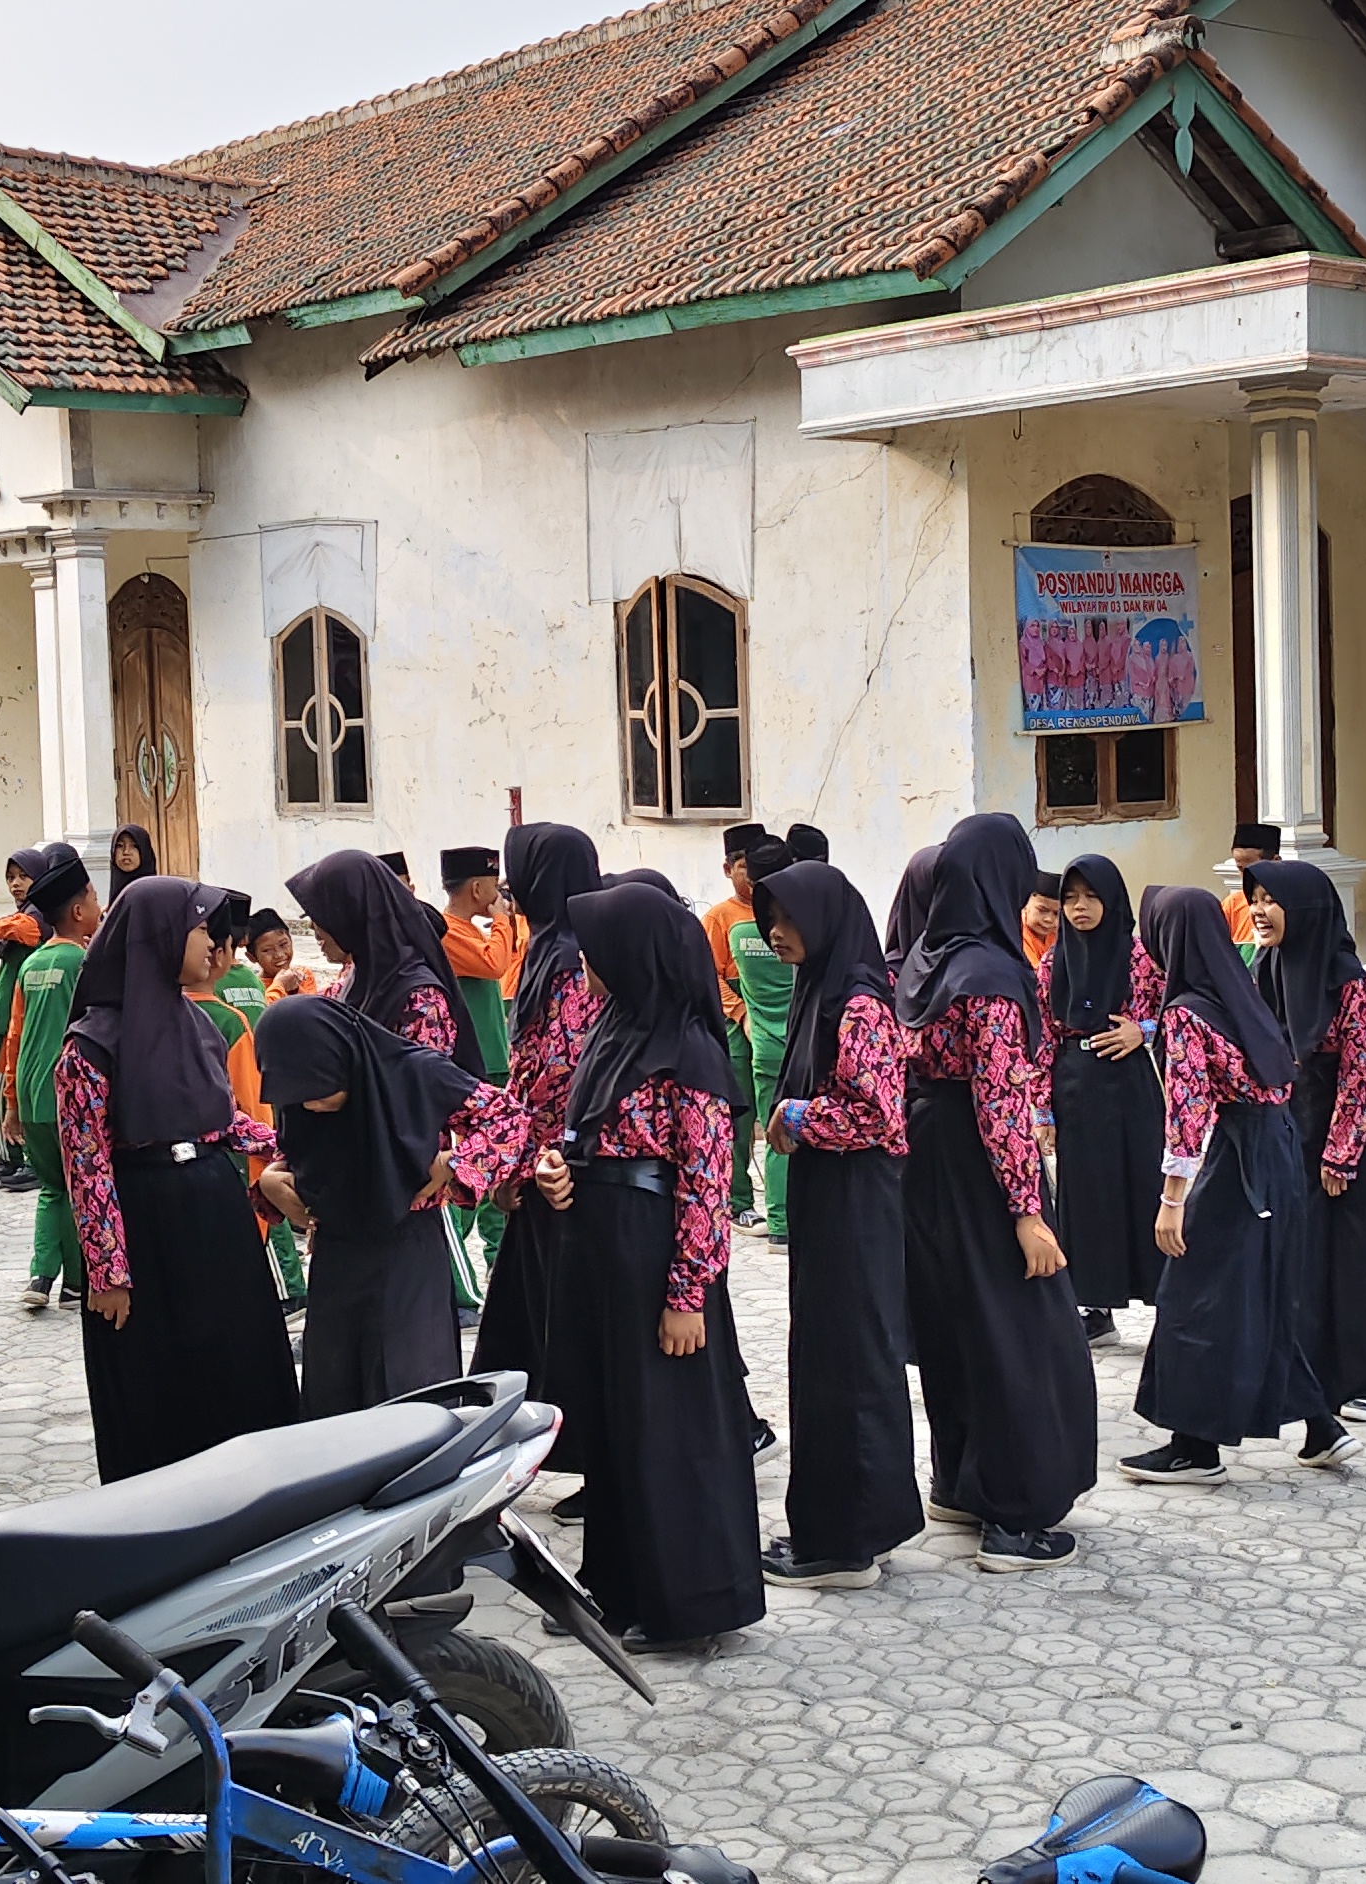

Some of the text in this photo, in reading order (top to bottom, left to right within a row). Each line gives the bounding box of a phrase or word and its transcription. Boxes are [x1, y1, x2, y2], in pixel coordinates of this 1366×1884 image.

[1036, 570, 1186, 596] POSYANDU MANGGA
[1110, 601, 1122, 613] 03
[1123, 600, 1141, 613] DAN
[1143, 600, 1155, 613] RW
[1156, 600, 1168, 612] 04
[1029, 714, 1142, 730] DESA RENGASPENDAWA
